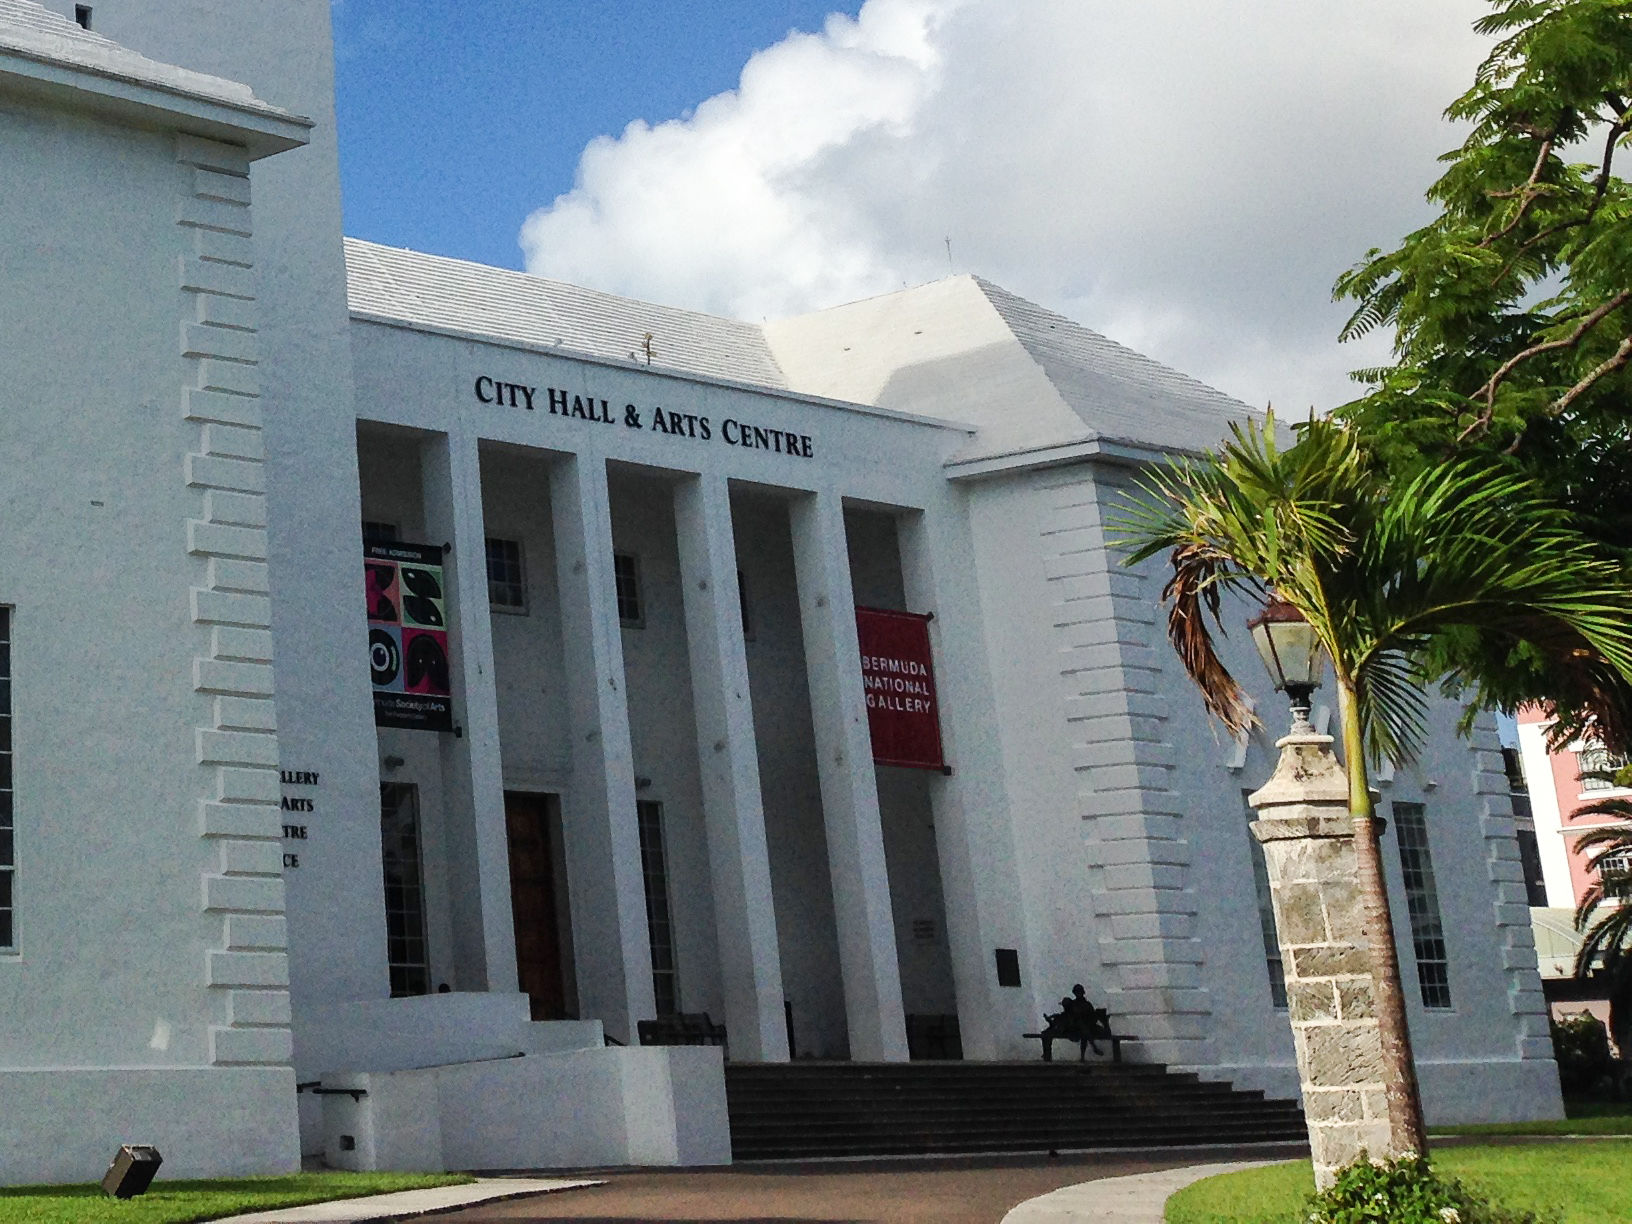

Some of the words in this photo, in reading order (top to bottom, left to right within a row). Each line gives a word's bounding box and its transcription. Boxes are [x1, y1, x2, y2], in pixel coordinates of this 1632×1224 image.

[474, 375, 535, 410] CITY
[547, 388, 615, 424] HALL
[624, 404, 643, 429] &
[652, 407, 711, 441] ARTS
[722, 418, 814, 458] CENTRE
[862, 655, 927, 676] BERMUDA
[864, 675, 930, 696] NATIONAL
[867, 694, 931, 714] GALLERY
[280, 770, 319, 785] LLERY
[281, 796, 314, 812] ARTS
[282, 825, 308, 840] TRE
[283, 853, 299, 868] CE
